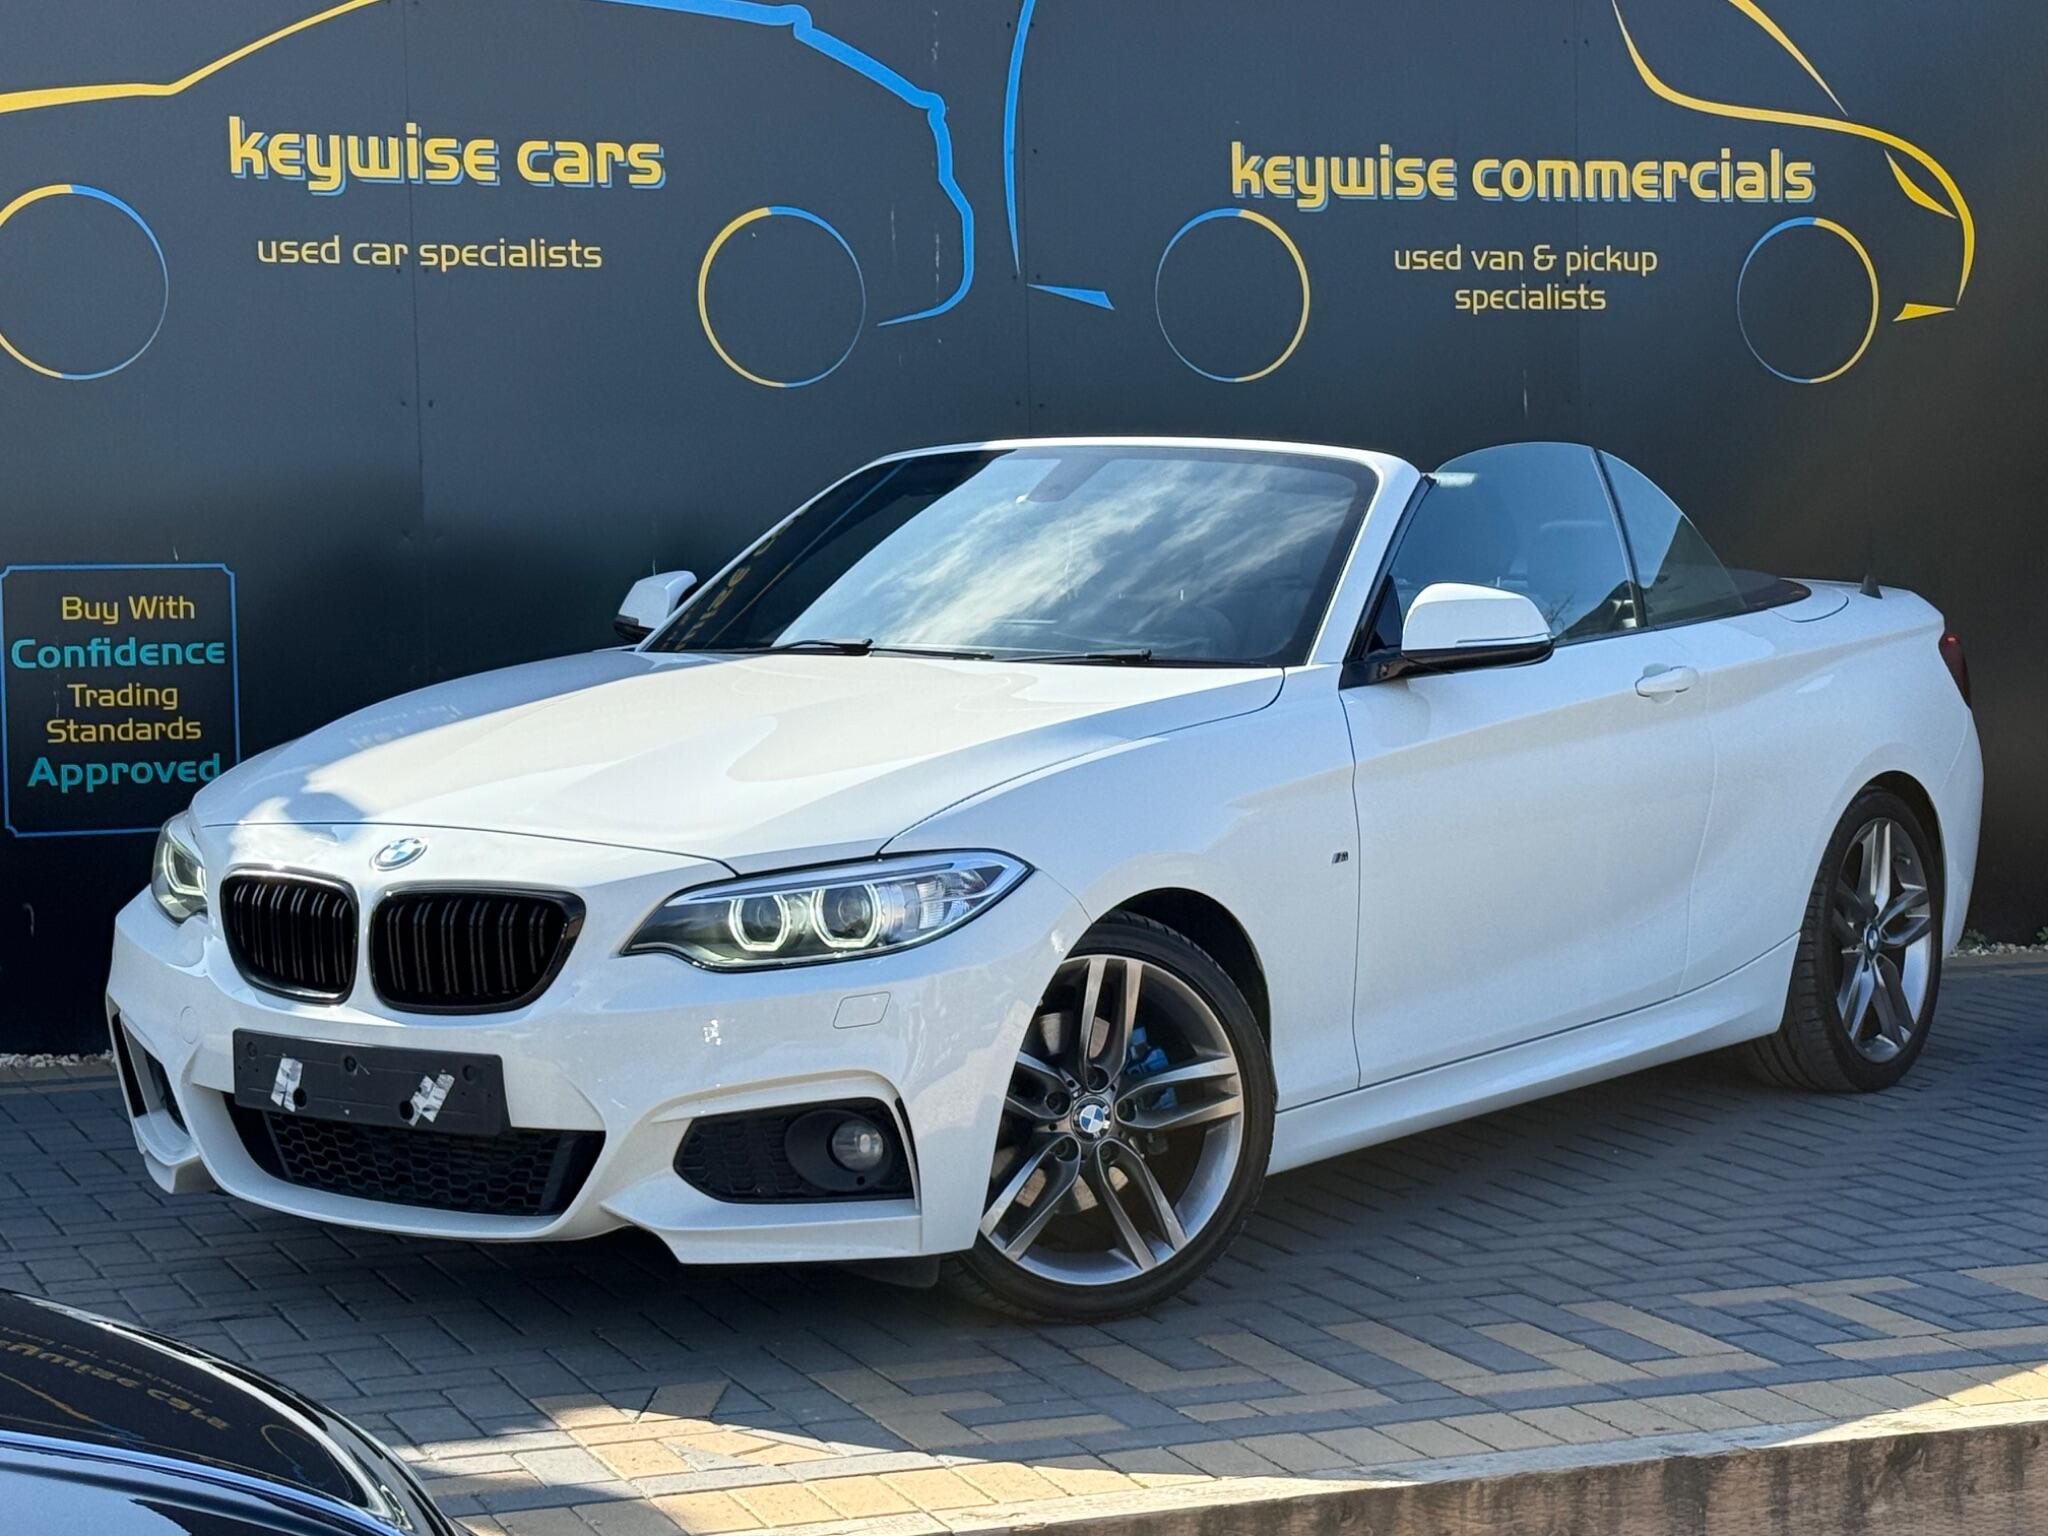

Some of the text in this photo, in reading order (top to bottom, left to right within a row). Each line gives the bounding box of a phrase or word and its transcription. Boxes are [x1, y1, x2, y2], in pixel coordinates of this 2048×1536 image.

[228, 116, 666, 196] keywise cars
[1231, 141, 1816, 212] keywise commercials
[257, 235, 603, 273] used car specialists
[1394, 244, 1658, 277] used van & pickup
[1454, 283, 1607, 315] specialists
[61, 595, 196, 625] Buy With
[10, 636, 226, 669] Confidence
[66, 682, 179, 711] Trading
[46, 716, 202, 744] Standards
[27, 752, 221, 793] Approved
